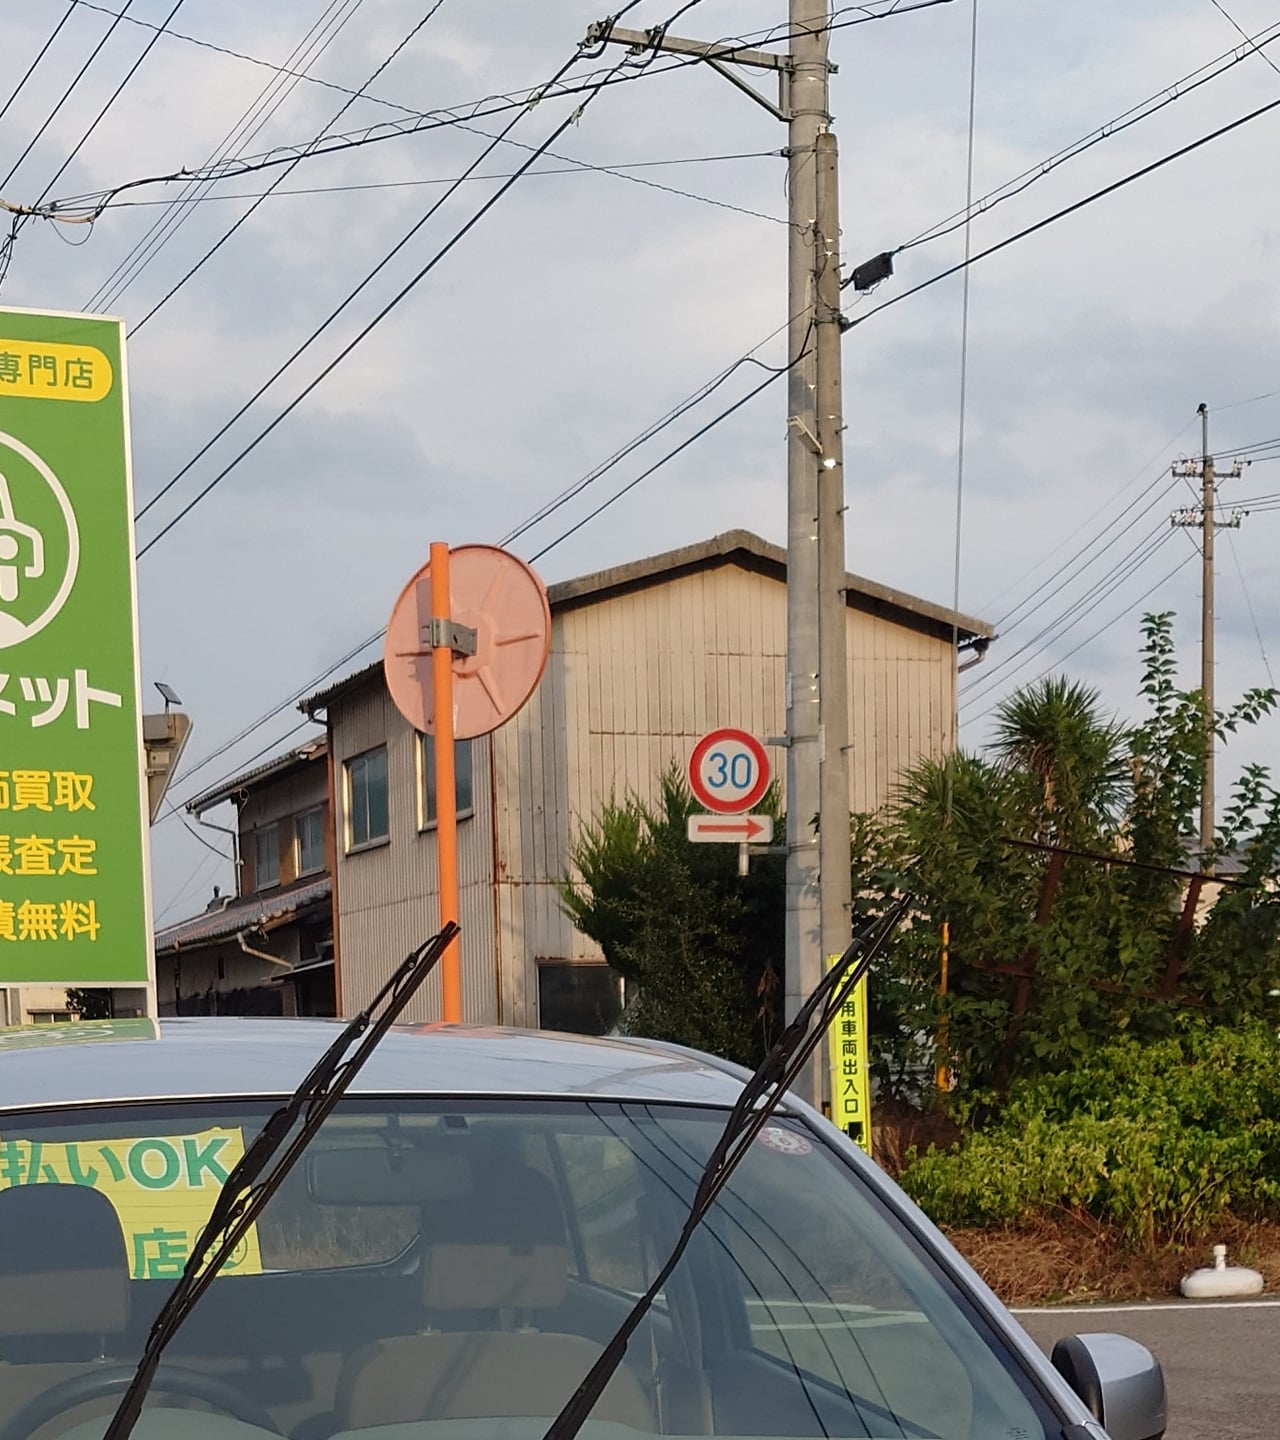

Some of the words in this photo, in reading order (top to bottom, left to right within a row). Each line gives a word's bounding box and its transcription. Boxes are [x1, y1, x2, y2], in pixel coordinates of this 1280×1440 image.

[707, 752, 752, 790] 30
[840, 970, 859, 1114] 用車両出入口
